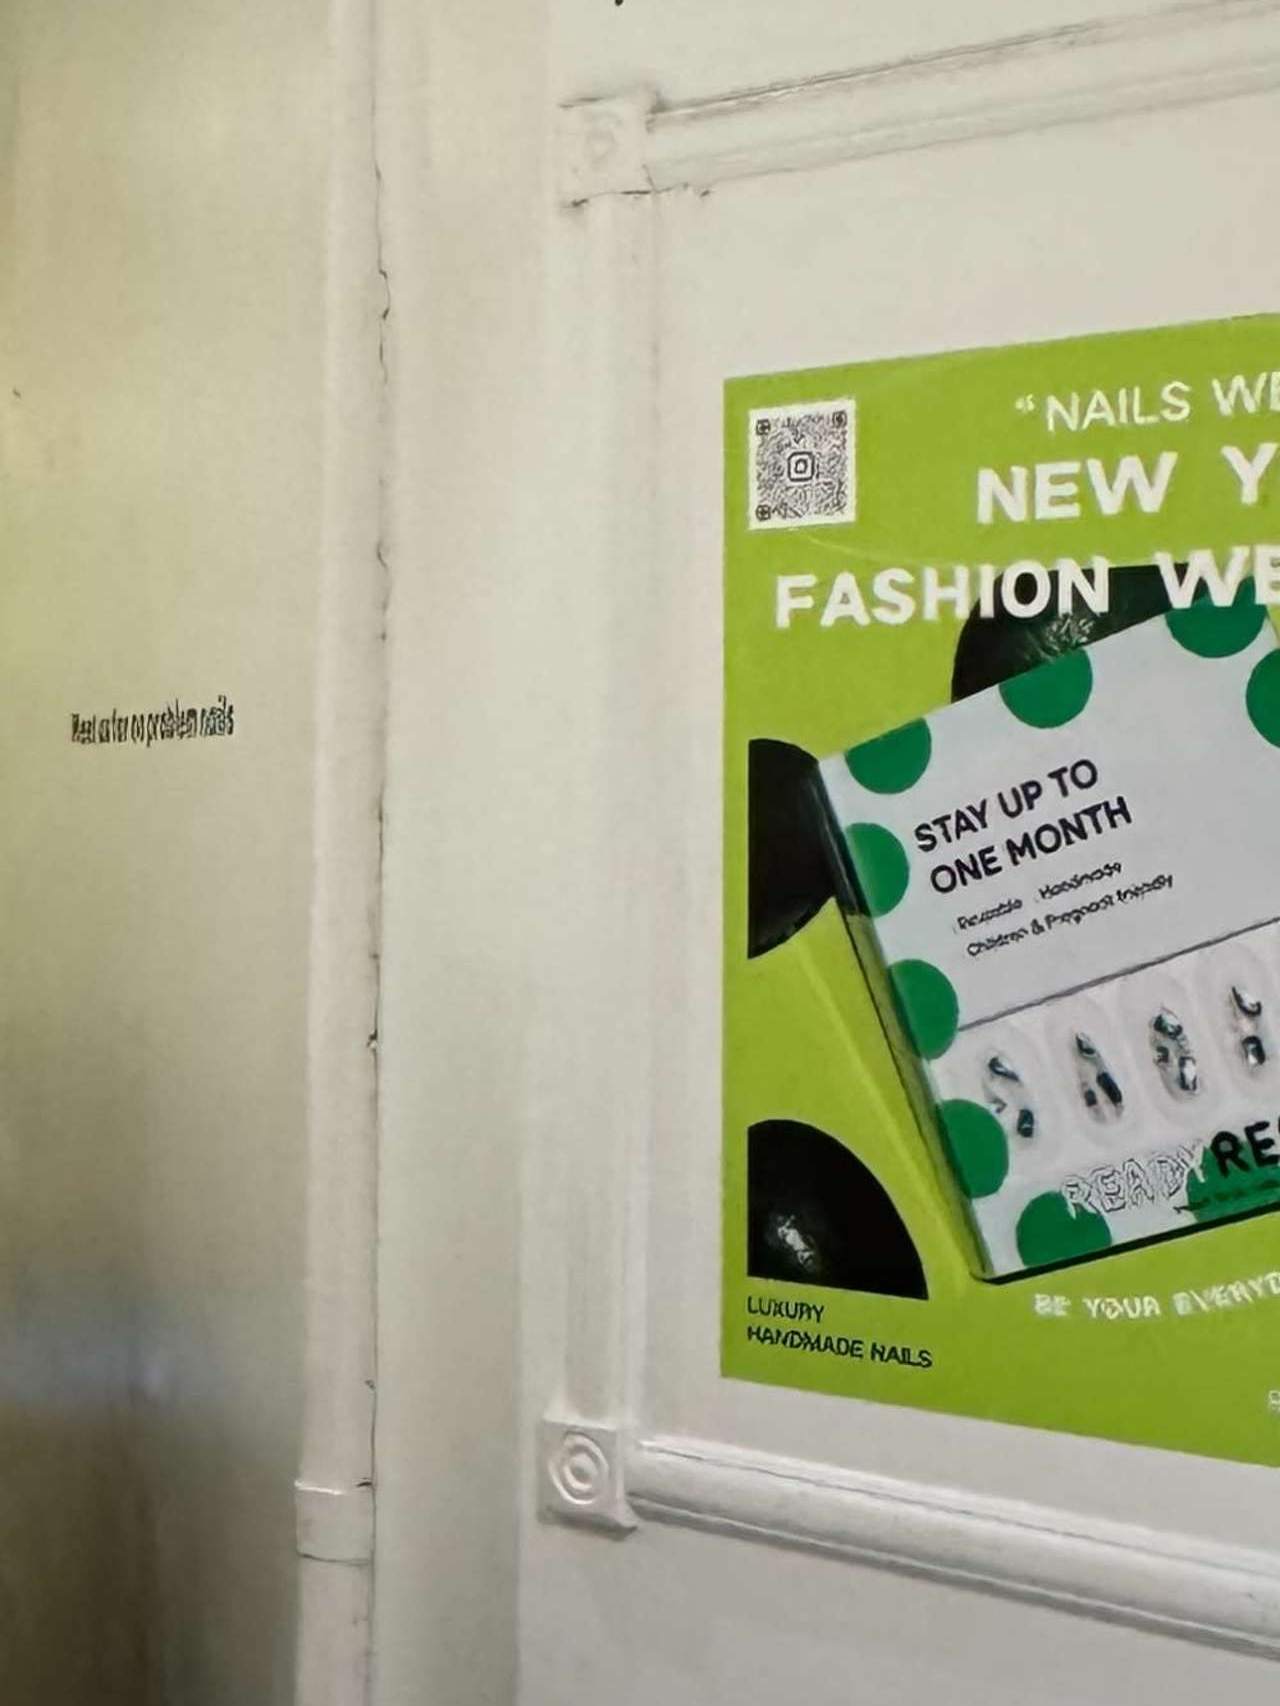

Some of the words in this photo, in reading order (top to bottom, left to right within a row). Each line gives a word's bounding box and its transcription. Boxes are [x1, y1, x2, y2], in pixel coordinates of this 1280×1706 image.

[977, 450, 1178, 524] NEW
[1221, 441, 1278, 505] Y
[775, 553, 1111, 629] FASHION
[914, 799, 988, 853] STAY
[997, 780, 1042, 818] UP
[1047, 759, 1098, 797] TO
[930, 845, 1002, 894] ONE
[1005, 796, 1132, 866] MONTH
[747, 1295, 825, 1323] LUXURY
[747, 1326, 864, 1360] HANDMADE
[870, 1342, 933, 1369] NAILS
